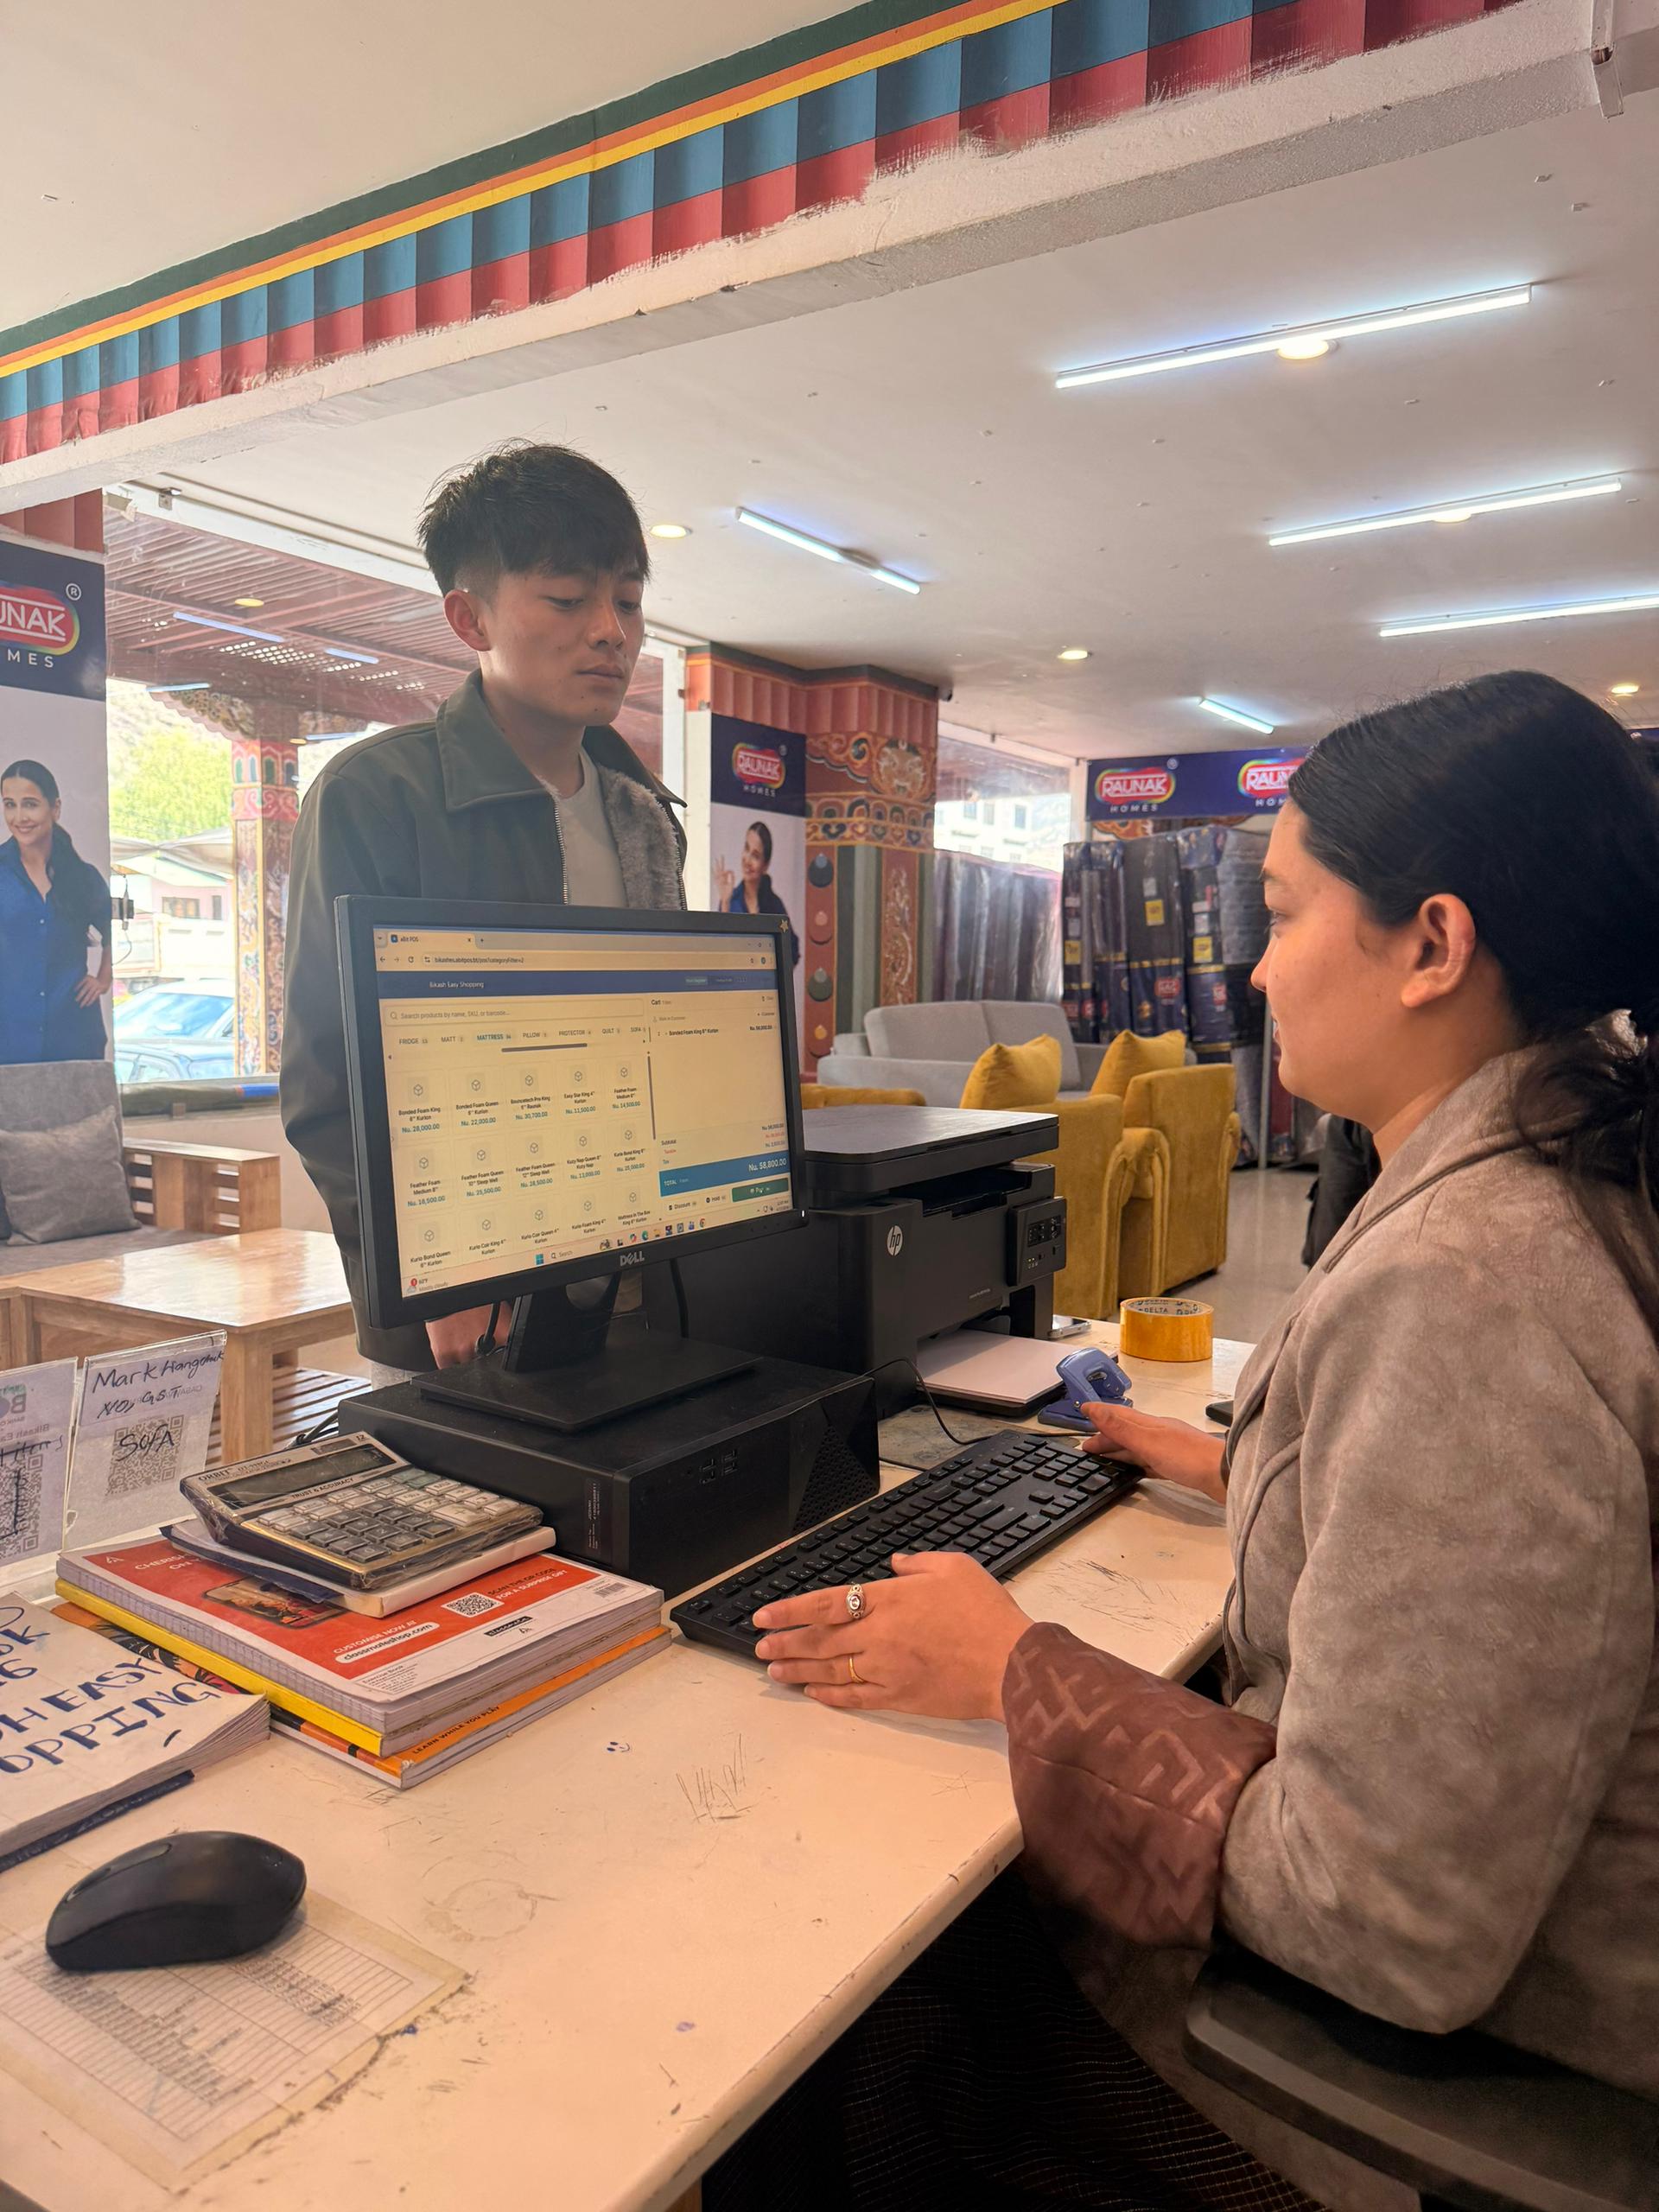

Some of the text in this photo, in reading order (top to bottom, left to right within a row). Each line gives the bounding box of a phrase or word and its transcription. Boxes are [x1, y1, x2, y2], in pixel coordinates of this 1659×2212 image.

[7, 649, 54, 668] MES
[737, 753, 781, 779] RAUNAK
[1102, 776, 1166, 798] RAUNAK
[1246, 768, 1290, 791] RAUN
[744, 785, 775, 797] HOMES
[1109, 804, 1158, 812] HOMES
[524, 1111, 548, 1120] 30,700.00
[413, 1123, 440, 1132] 28,000.00
[748, 1158, 787, 1173] Nu. 58,800.00
[620, 1251, 645, 1267] DELL
[92, 1362, 158, 1393] Mark
[199, 1469, 230, 1481] ORBIT
[291, 1489, 314, 1500] TRUST
[319, 1478, 354, 1493] ACCURACY
[487, 1584, 509, 1595] SCAN
[508, 1579, 524, 1587] THE
[496, 1590, 513, 1599] FOR
[518, 1575, 552, 1591] SURPRISE
[552, 1569, 567, 1578] GIFT
[334, 1633, 381, 1654] CUSTOMISE
[381, 1624, 405, 1637] NOW
[344, 1624, 433, 1661] classmateshop.com
[41, 1657, 162, 1713] EASY
[0, 1681, 222, 1774] OPPING
[412, 1706, 501, 1755] LEARN WHILE YOU PLAY
